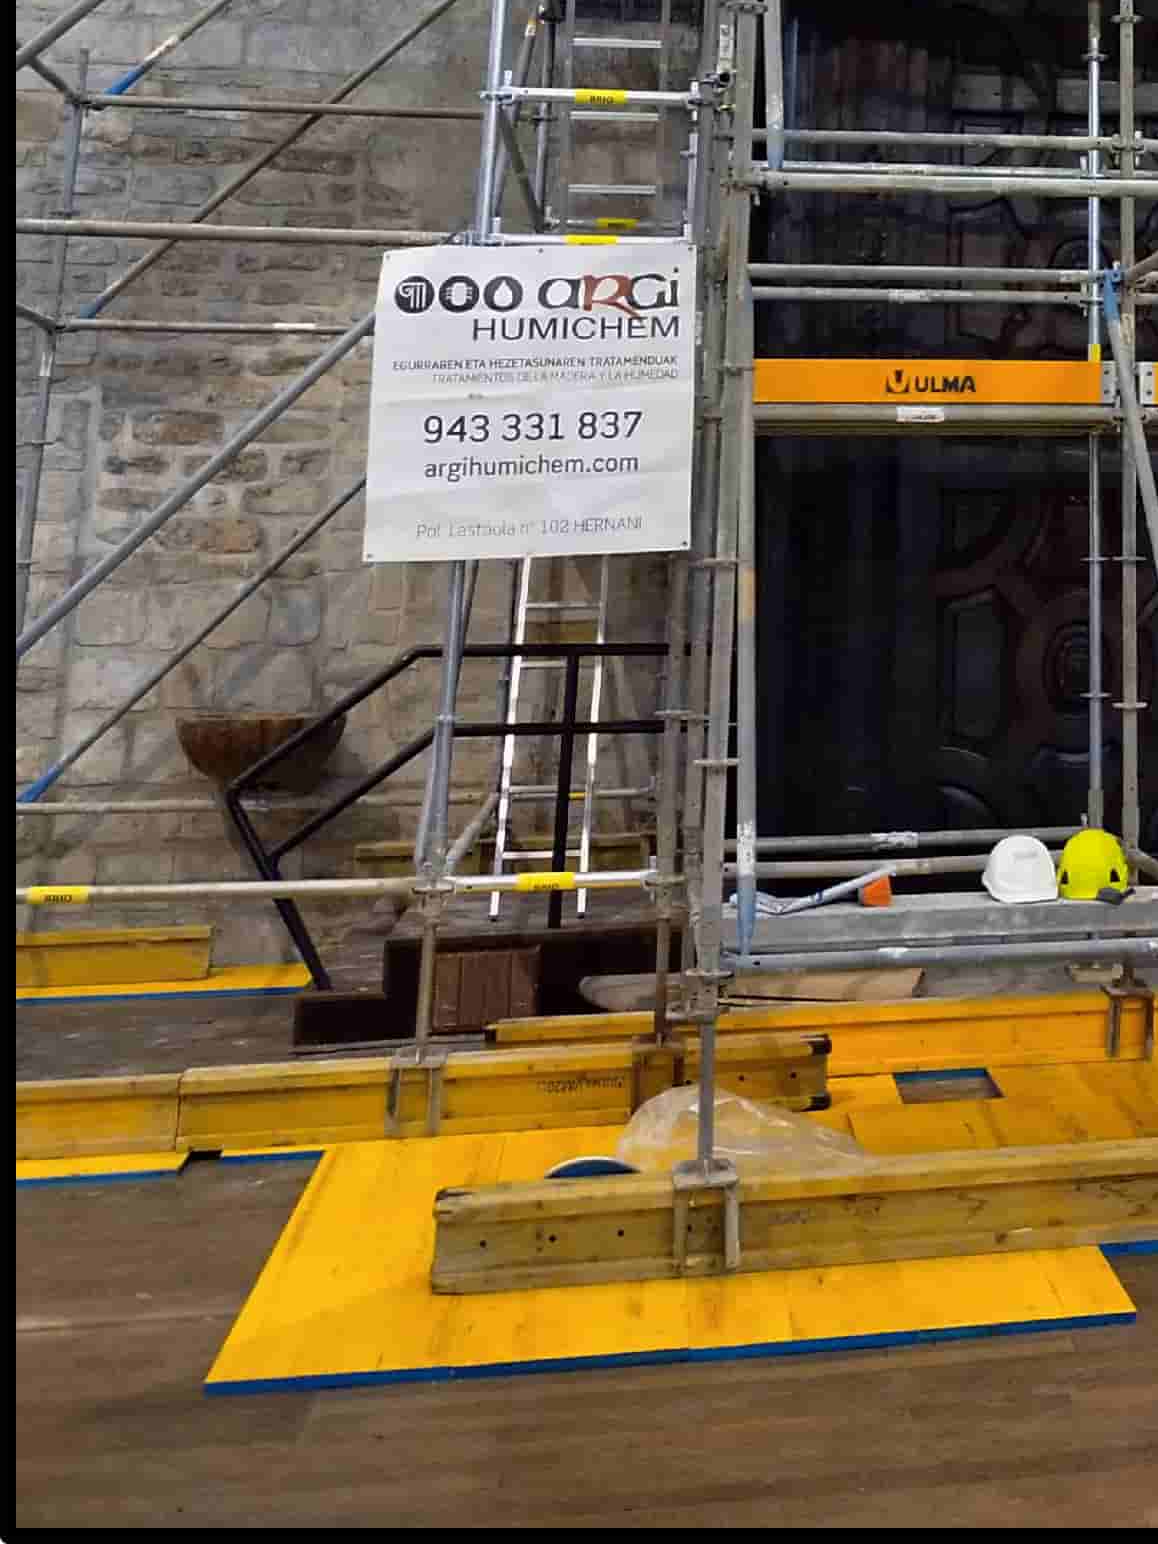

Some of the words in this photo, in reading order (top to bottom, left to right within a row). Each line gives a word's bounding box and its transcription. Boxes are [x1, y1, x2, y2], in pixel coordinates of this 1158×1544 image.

[472, 315, 680, 341] HUMICHEM
[466, 359, 486, 369] ETA
[914, 376, 976, 393] ULMA
[424, 414, 491, 443] 943
[501, 412, 565, 441] 331
[577, 410, 644, 439] 837
[424, 454, 639, 482] argihumichem.com
[541, 519, 570, 534] 102
[574, 516, 643, 533] HERNANI
